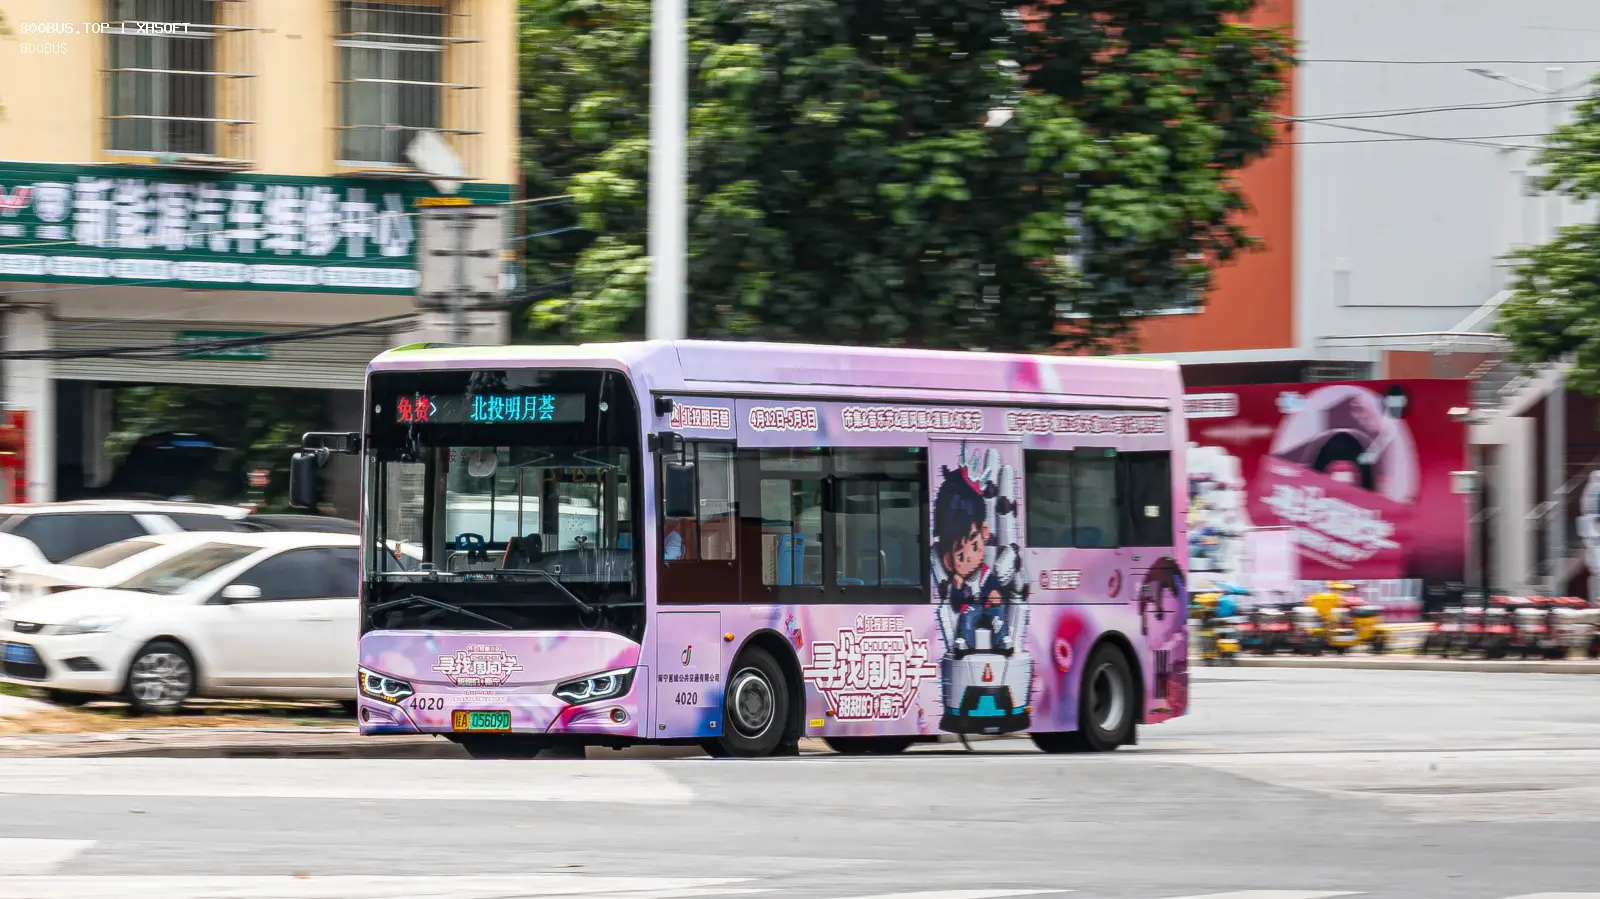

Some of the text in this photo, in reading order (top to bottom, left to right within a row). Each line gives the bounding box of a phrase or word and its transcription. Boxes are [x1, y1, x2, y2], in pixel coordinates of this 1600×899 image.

[397, 396, 430, 422] 免费
[470, 395, 555, 421] 北投明月荟
[750, 409, 817, 429] 4月12日-5月5日
[432, 650, 524, 675] 寻找周同学
[802, 629, 938, 690] 寻找周同学
[410, 697, 444, 711] 4020
[675, 692, 698, 706] 4020
[472, 713, 510, 728] 05609D
